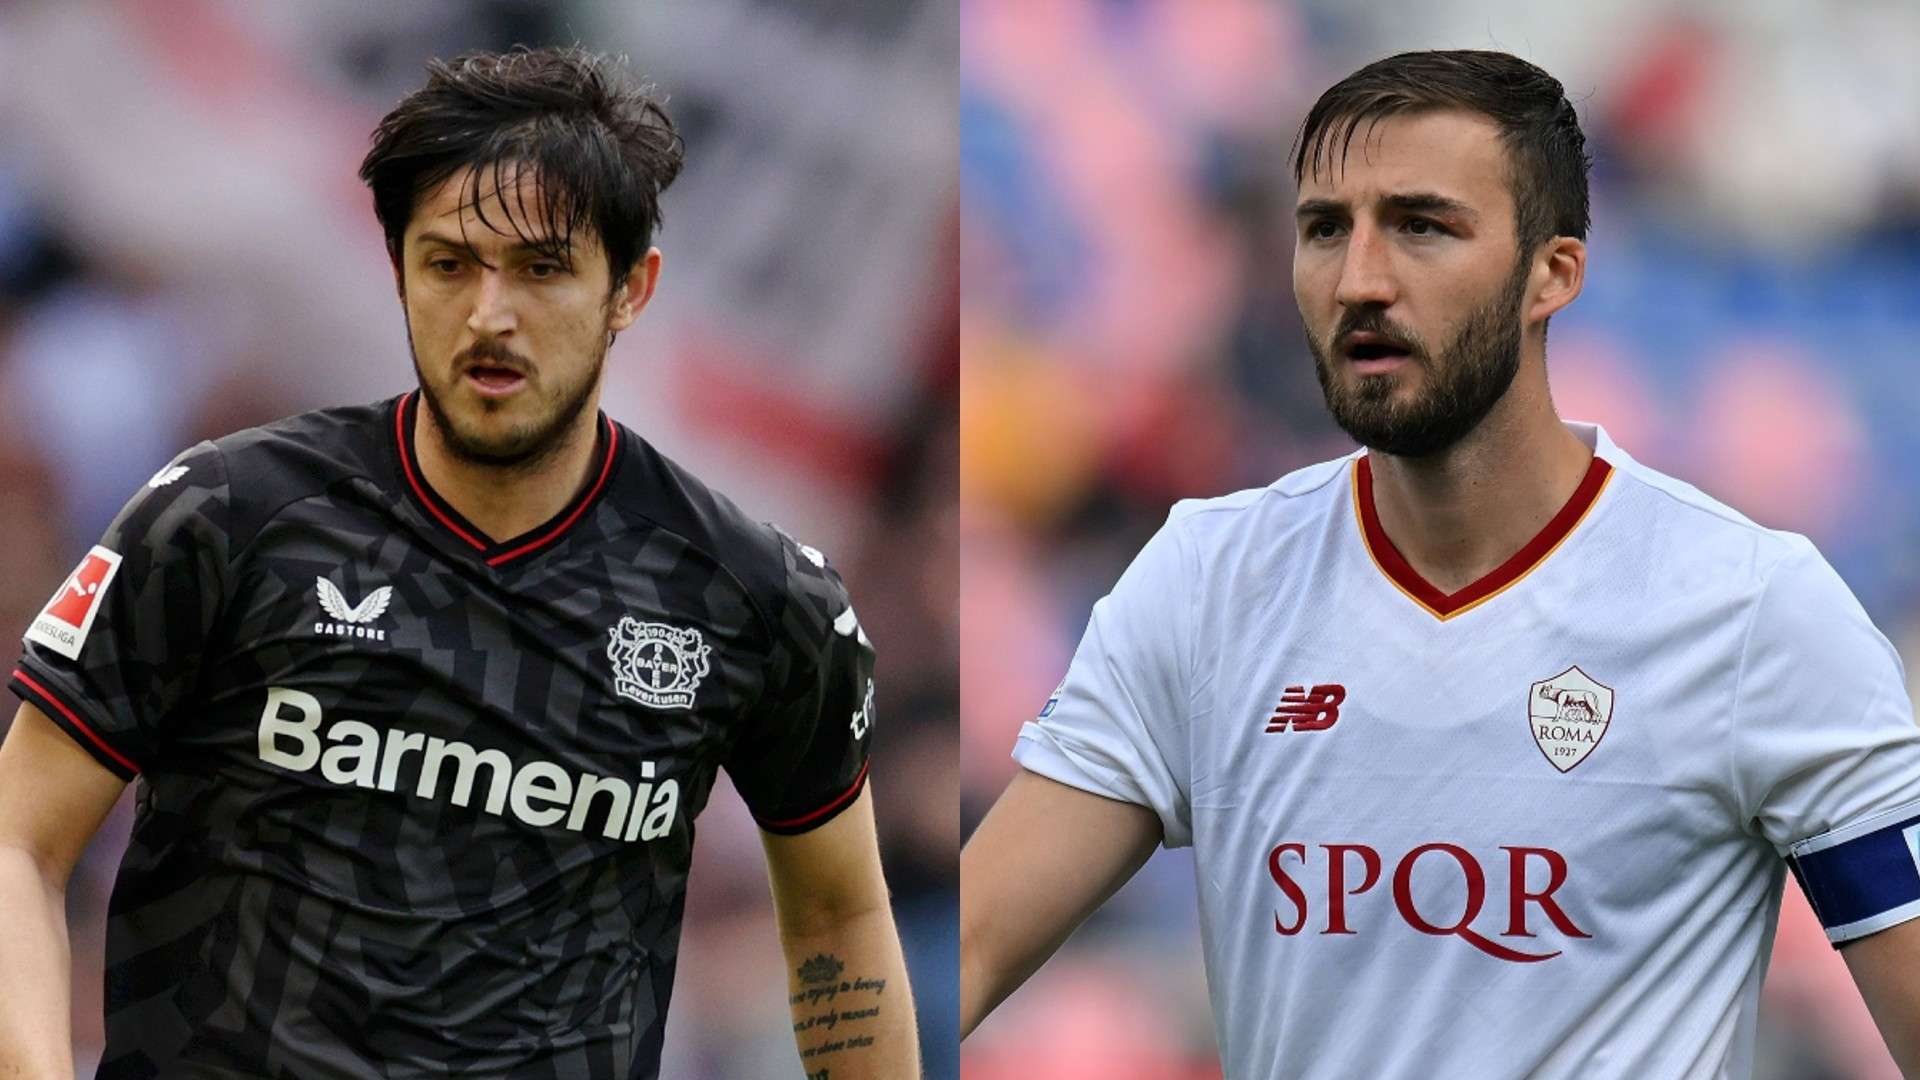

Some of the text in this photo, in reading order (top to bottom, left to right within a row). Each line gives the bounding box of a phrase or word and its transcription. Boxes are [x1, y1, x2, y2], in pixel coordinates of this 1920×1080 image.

[314, 622, 385, 641] CASTORE
[646, 627, 674, 641] 1904
[636, 657, 678, 674] BAYER
[621, 682, 688, 704] Leverkusen
[1539, 725, 1595, 743] ROMA
[1554, 746, 1577, 757] 1927
[258, 687, 679, 842] Barmenia
[1268, 842, 1593, 963] SPQR
